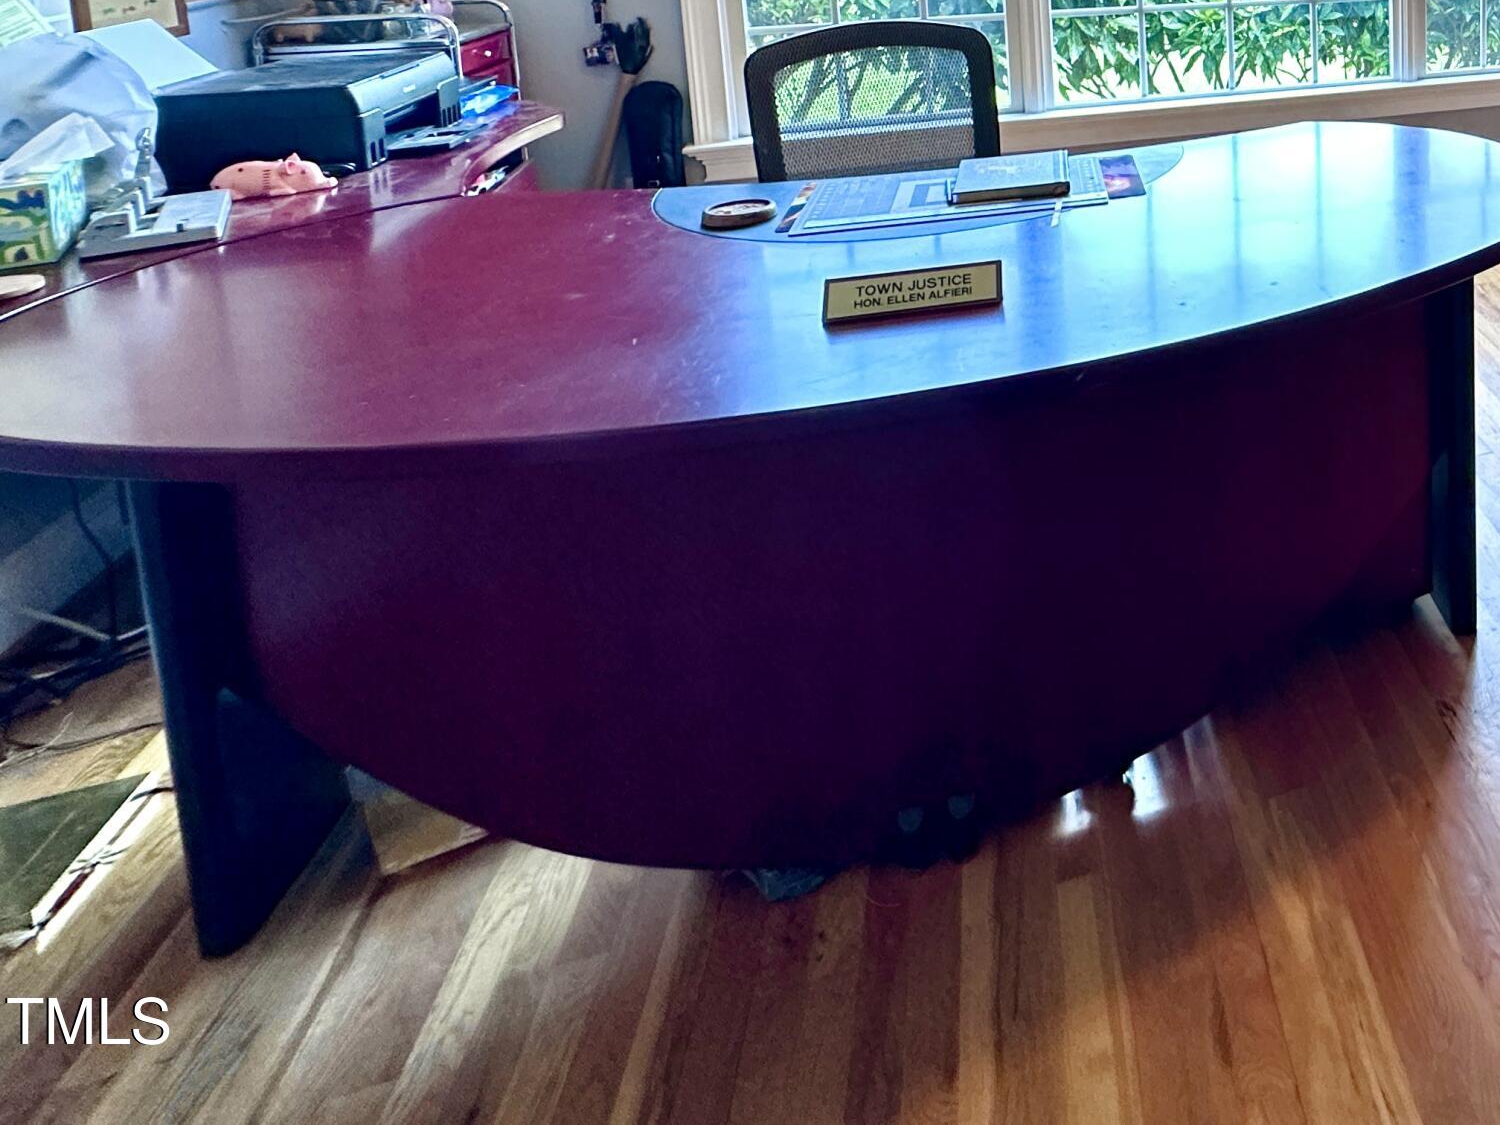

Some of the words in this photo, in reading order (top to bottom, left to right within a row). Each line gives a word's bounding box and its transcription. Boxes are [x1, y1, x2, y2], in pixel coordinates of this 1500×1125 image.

[853, 297, 884, 309] HON.
[887, 291, 926, 306] ELLEN
[927, 285, 973, 301] ALFIERI
[856, 281, 904, 298] TOWN
[907, 273, 972, 291] JUSTICE
